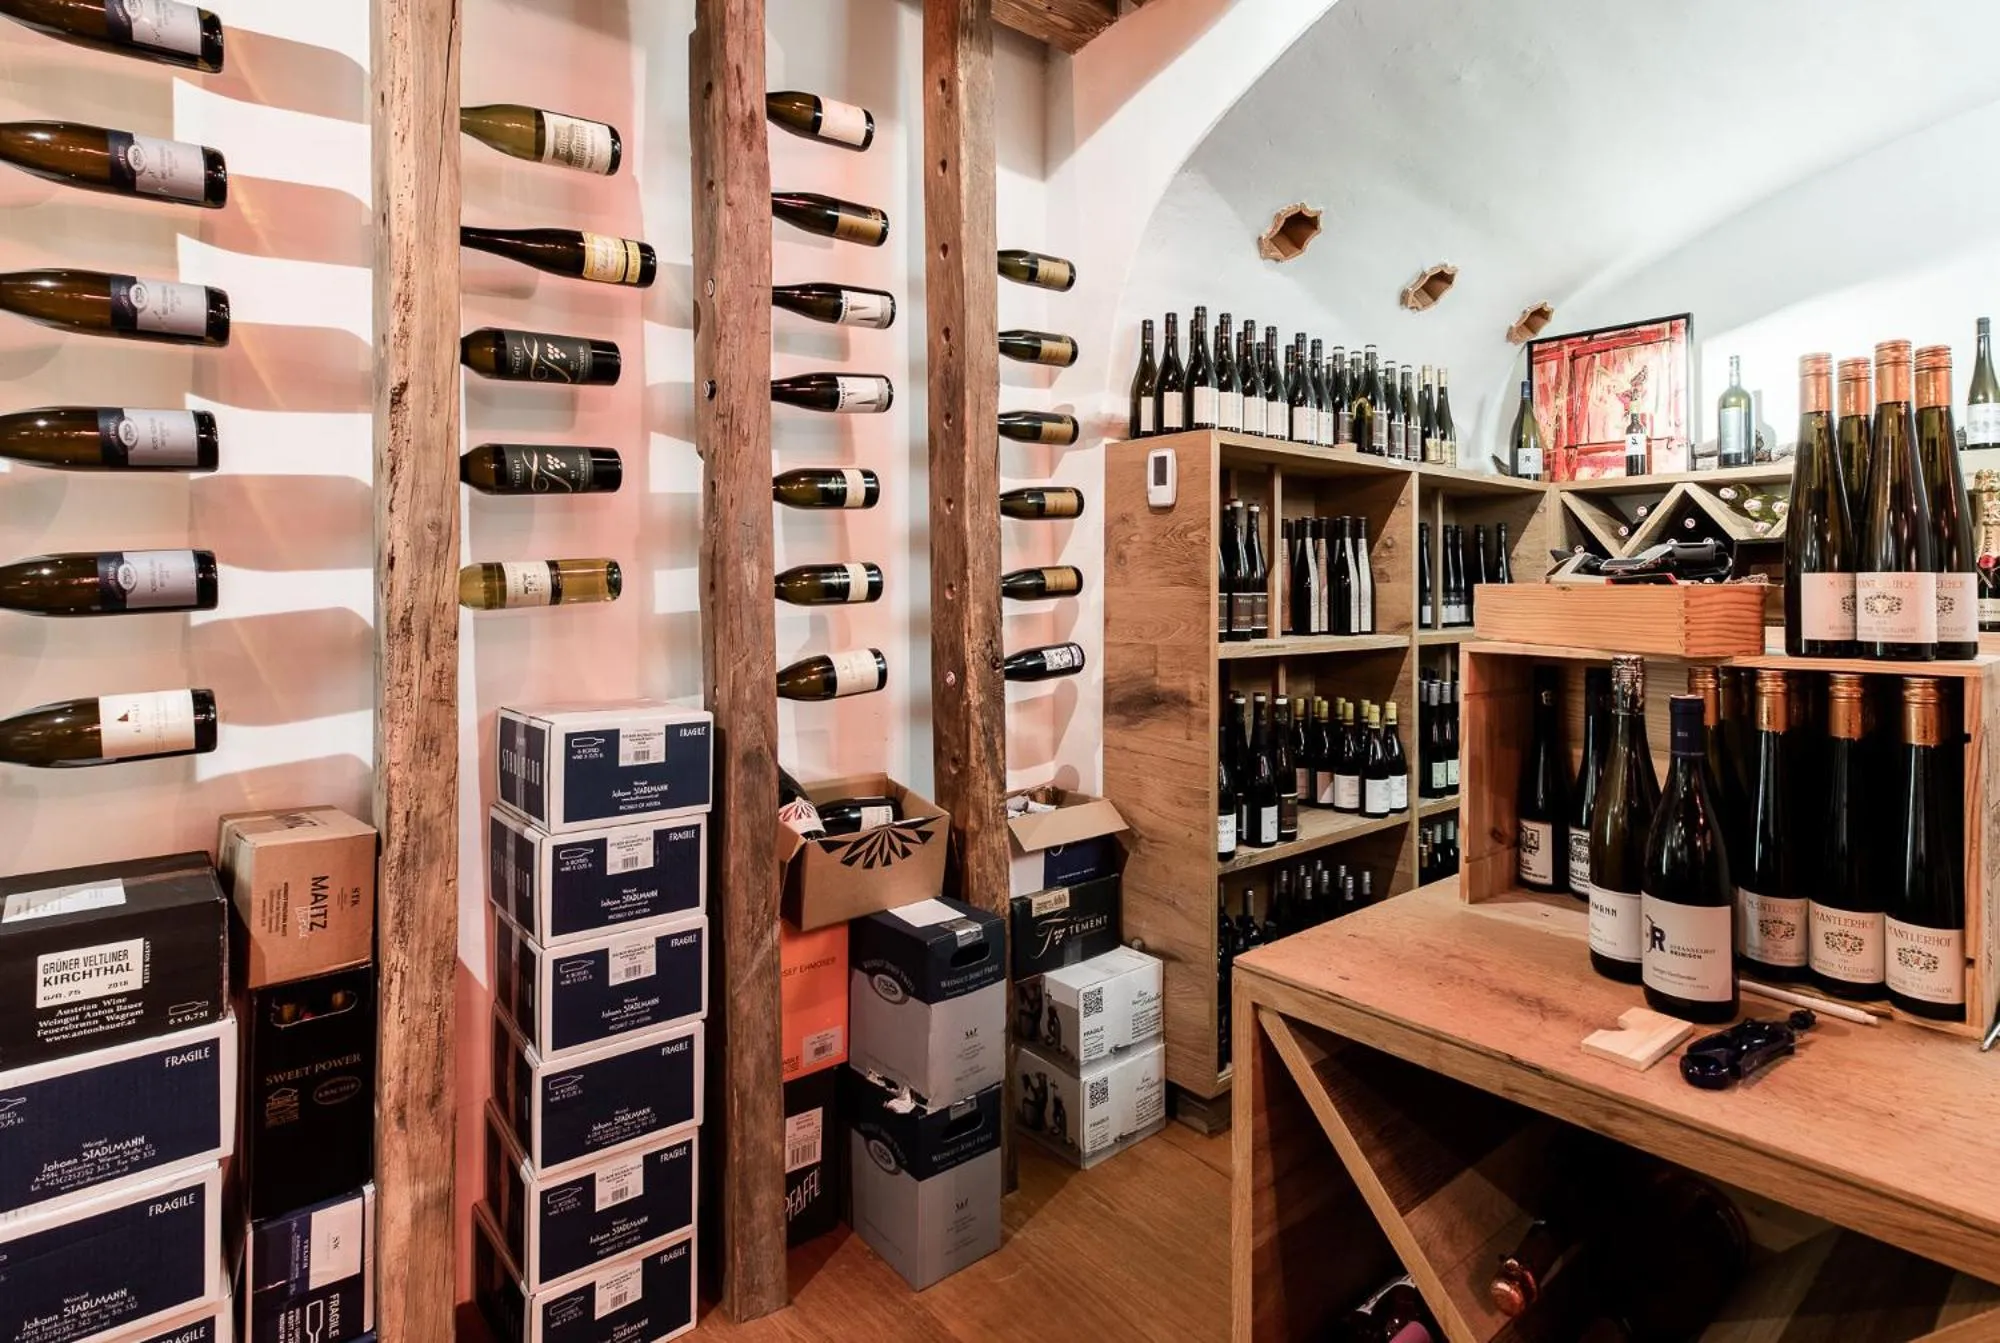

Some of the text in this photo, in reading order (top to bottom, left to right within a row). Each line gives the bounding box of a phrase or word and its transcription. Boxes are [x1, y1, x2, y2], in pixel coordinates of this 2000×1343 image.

[309, 875, 329, 931] MAITZ
[1069, 915, 1109, 935] TEMENT
[42, 949, 129, 975] GRÜNER VELTLINER
[43, 962, 133, 987] KIRCHTHAL
[38, 1002, 143, 1028] Weingut Anton Bauer
[56, 997, 128, 1017] Austrian Wine
[36, 1009, 144, 1037] Feuersbrunn Wagram
[165, 1047, 210, 1068] FRAGILE
[266, 1052, 361, 1086] SWEET POWER
[43, 1135, 145, 1173] Johann STADLMANN
[149, 1193, 196, 1216] FRAGILE
[23, 1288, 128, 1331] Johann STADLMANN
[328, 1293, 340, 1338] FRAGILE
